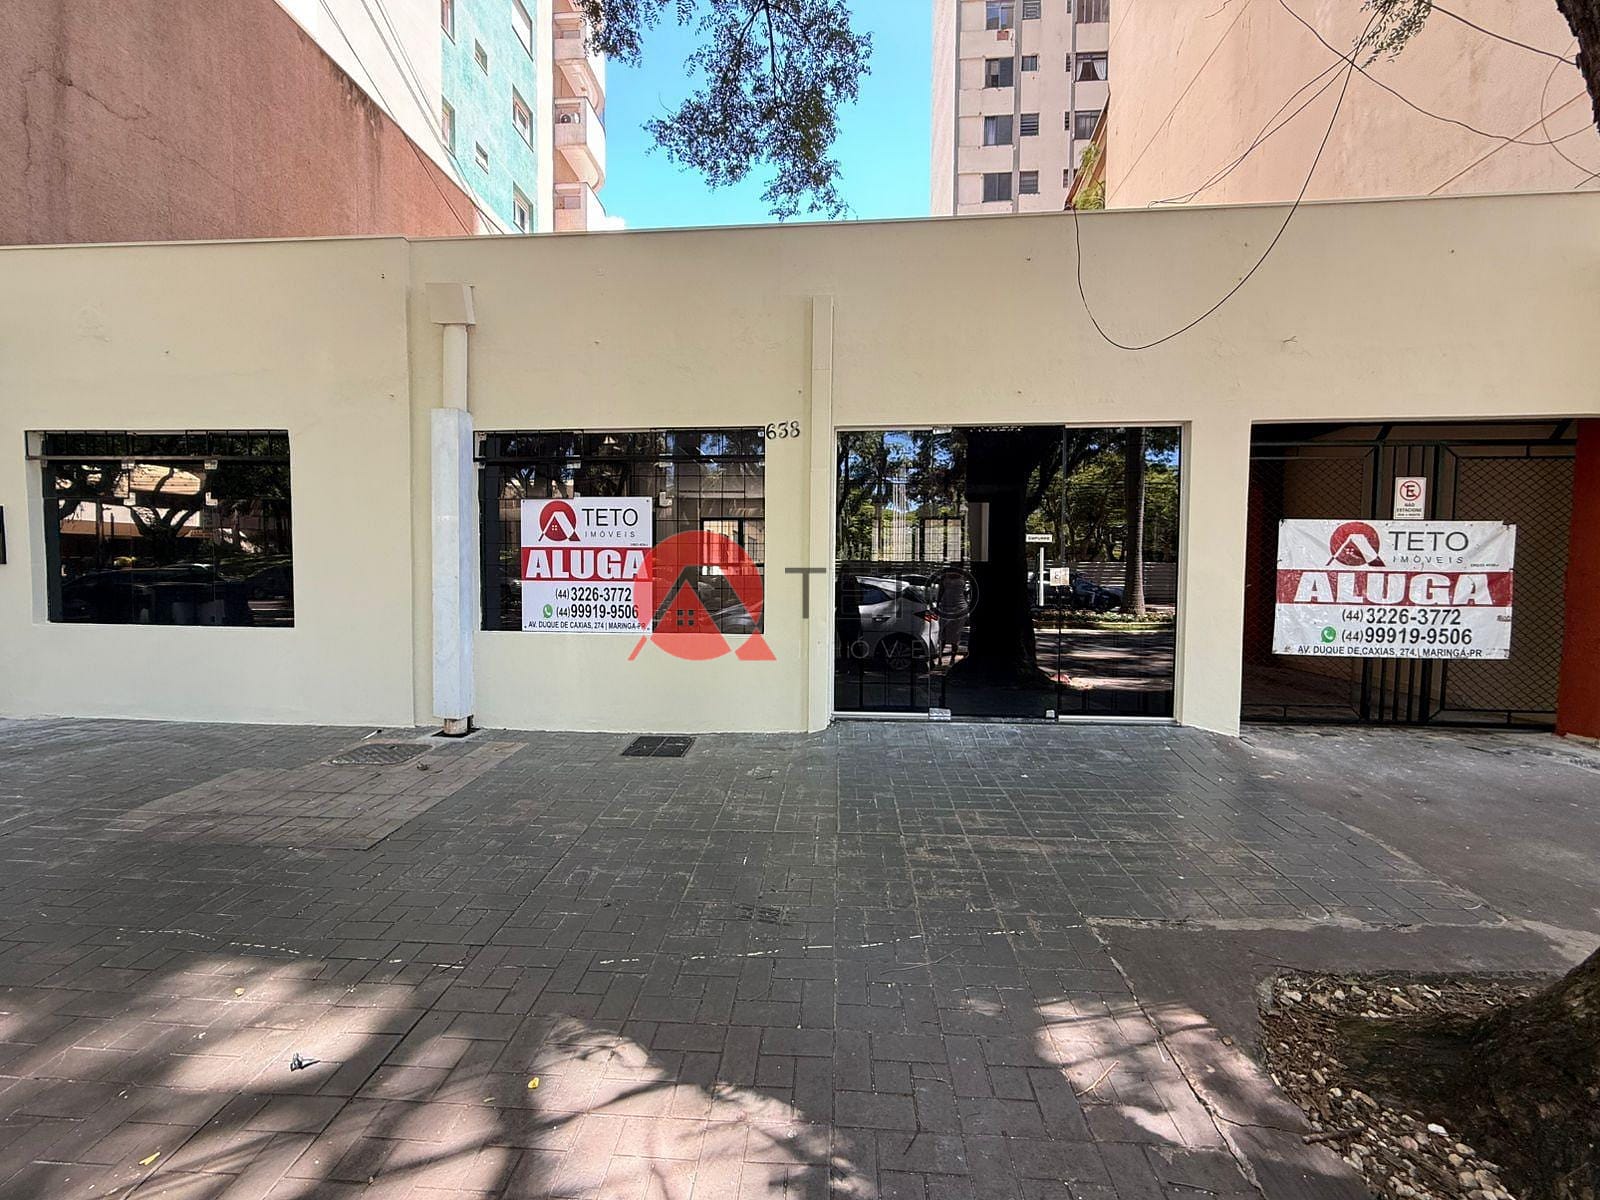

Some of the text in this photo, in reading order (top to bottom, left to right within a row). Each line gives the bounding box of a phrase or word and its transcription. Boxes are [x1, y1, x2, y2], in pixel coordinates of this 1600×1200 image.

[766, 420, 800, 440] 638
[581, 508, 639, 527] TETO
[584, 529, 637, 539] IMÓVEIS
[1388, 530, 1469, 552] TETO
[525, 549, 649, 580] ALUGA
[1392, 554, 1465, 565] IMÓVEIS
[1293, 571, 1493, 606] ALUGA
[538, 621, 559, 629] DUQUE
[560, 621, 569, 629] DE
[569, 621, 594, 630] CAXIAS,
[594, 621, 604, 629] 274
[1297, 645, 1311, 654] AV.
[1313, 645, 1345, 655] DUQUE
[1422, 646, 1482, 658] MARINGÁ-PR
